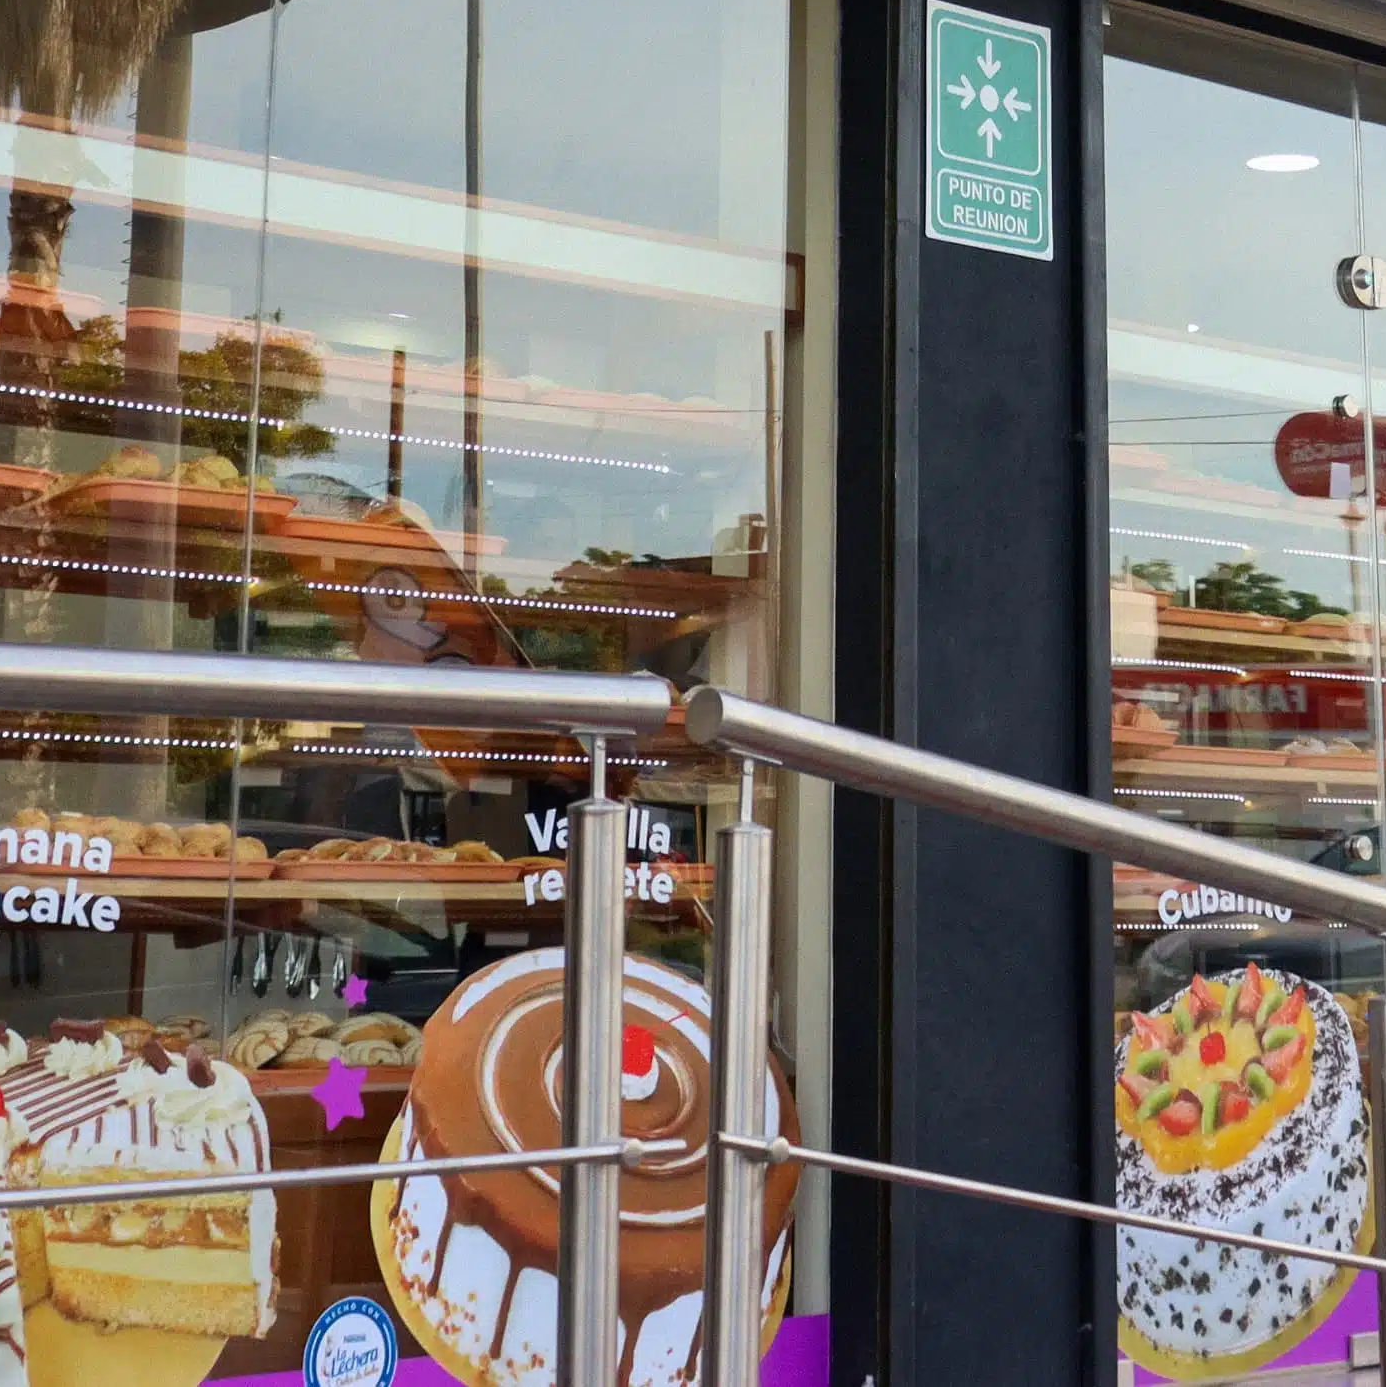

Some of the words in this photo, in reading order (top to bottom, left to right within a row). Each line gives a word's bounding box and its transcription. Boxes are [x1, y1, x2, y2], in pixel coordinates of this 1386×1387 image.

[949, 176, 1005, 206] PUNTO
[1010, 189, 1032, 211] DE
[953, 205, 1028, 236] REUNION
[524, 808, 671, 854] Valla
